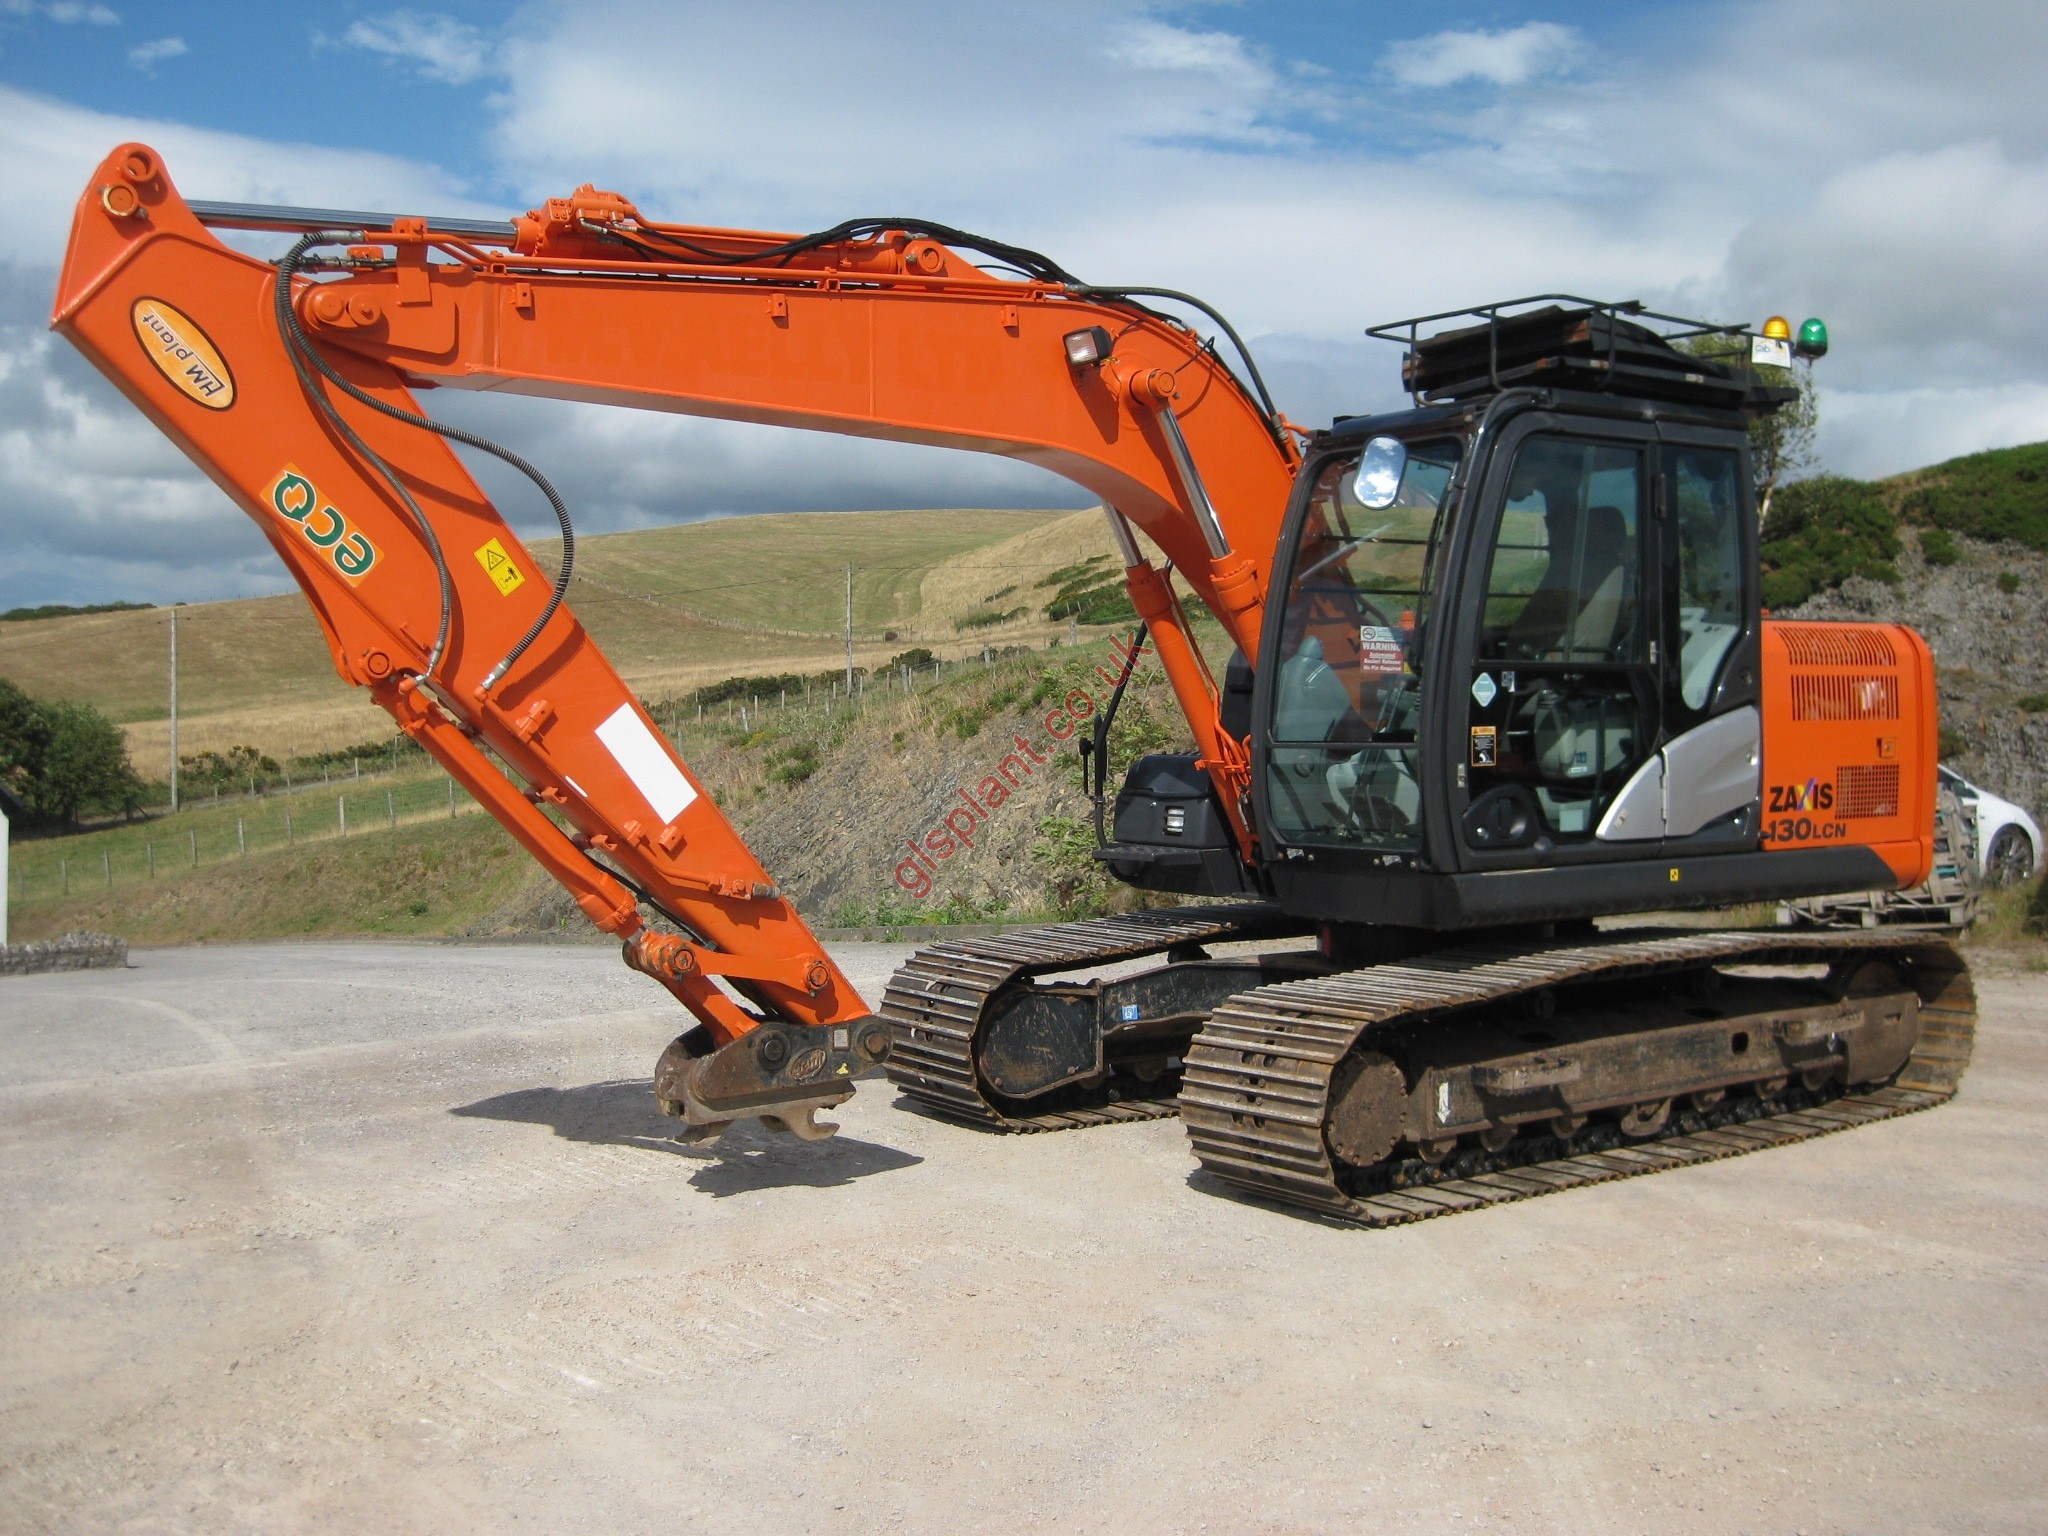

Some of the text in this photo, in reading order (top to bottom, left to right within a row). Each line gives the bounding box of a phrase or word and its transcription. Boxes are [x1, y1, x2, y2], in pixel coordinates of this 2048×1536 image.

[141, 314, 225, 398] HM plant
[1769, 776, 1834, 813] ZAXIS
